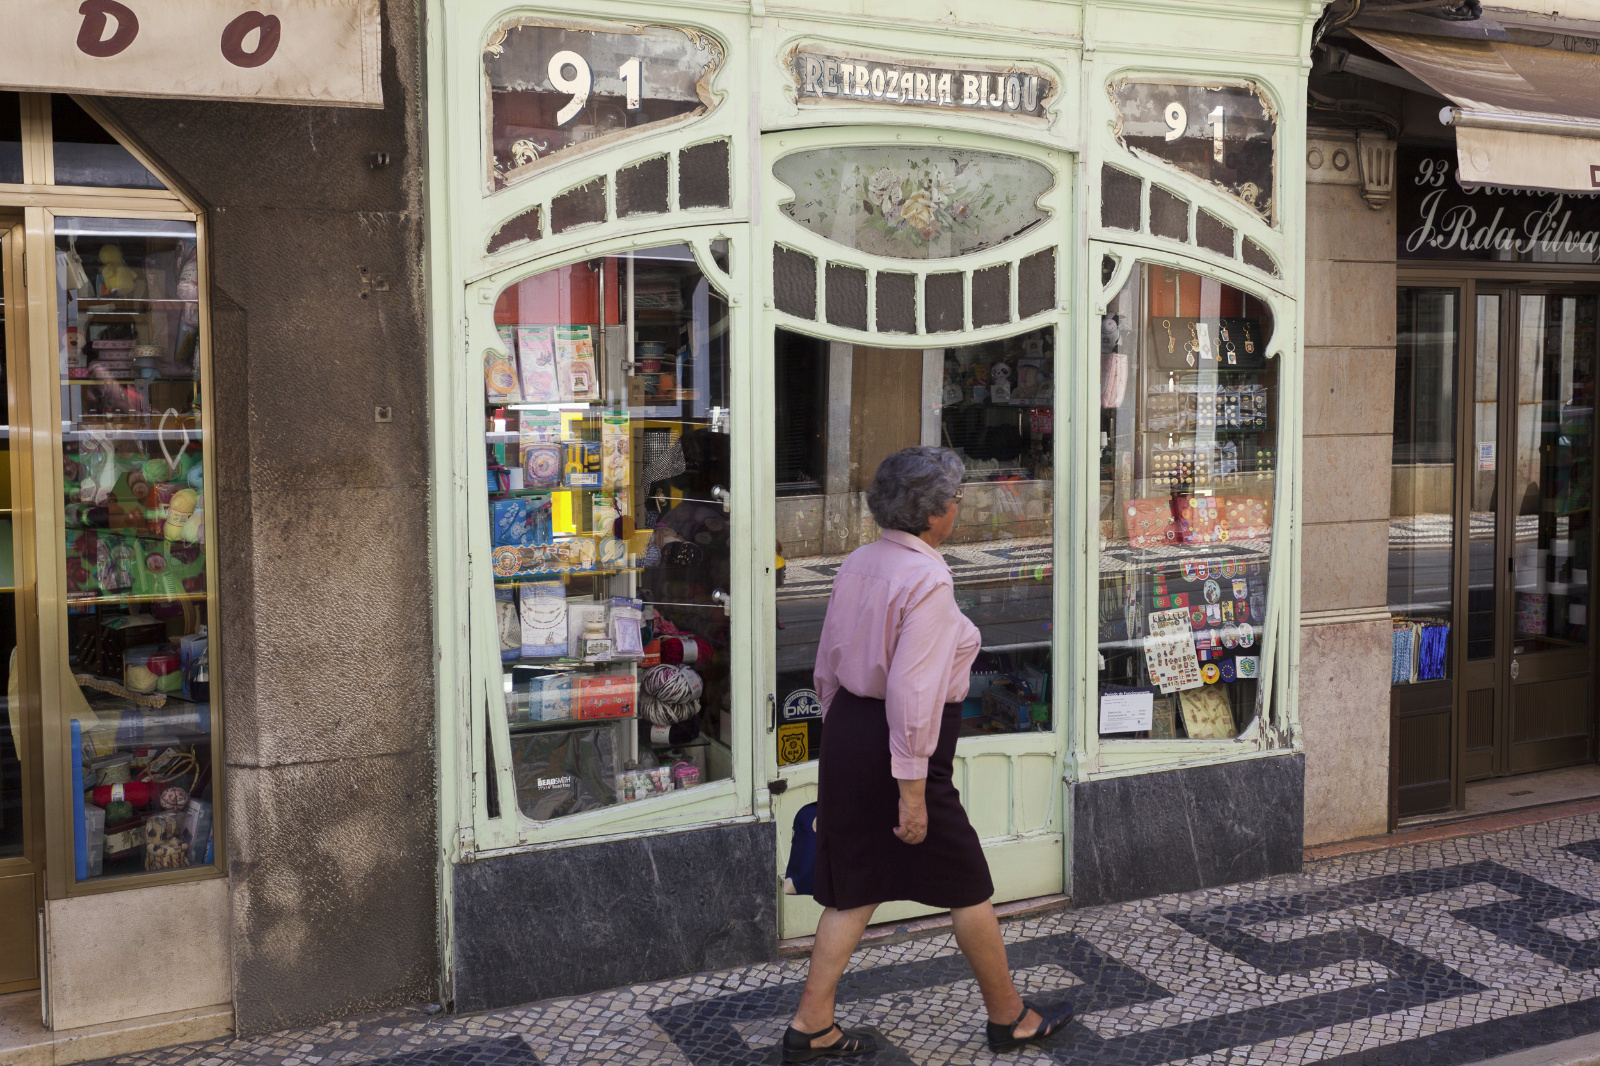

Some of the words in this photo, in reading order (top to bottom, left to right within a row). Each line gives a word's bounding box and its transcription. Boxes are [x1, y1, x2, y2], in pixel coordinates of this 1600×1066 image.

[547, 50, 643, 127] 91
[805, 57, 953, 106] RETROZARIA
[1164, 102, 1226, 168] 91
[1414, 157, 1449, 187] 93
[785, 704, 822, 716] DMC
